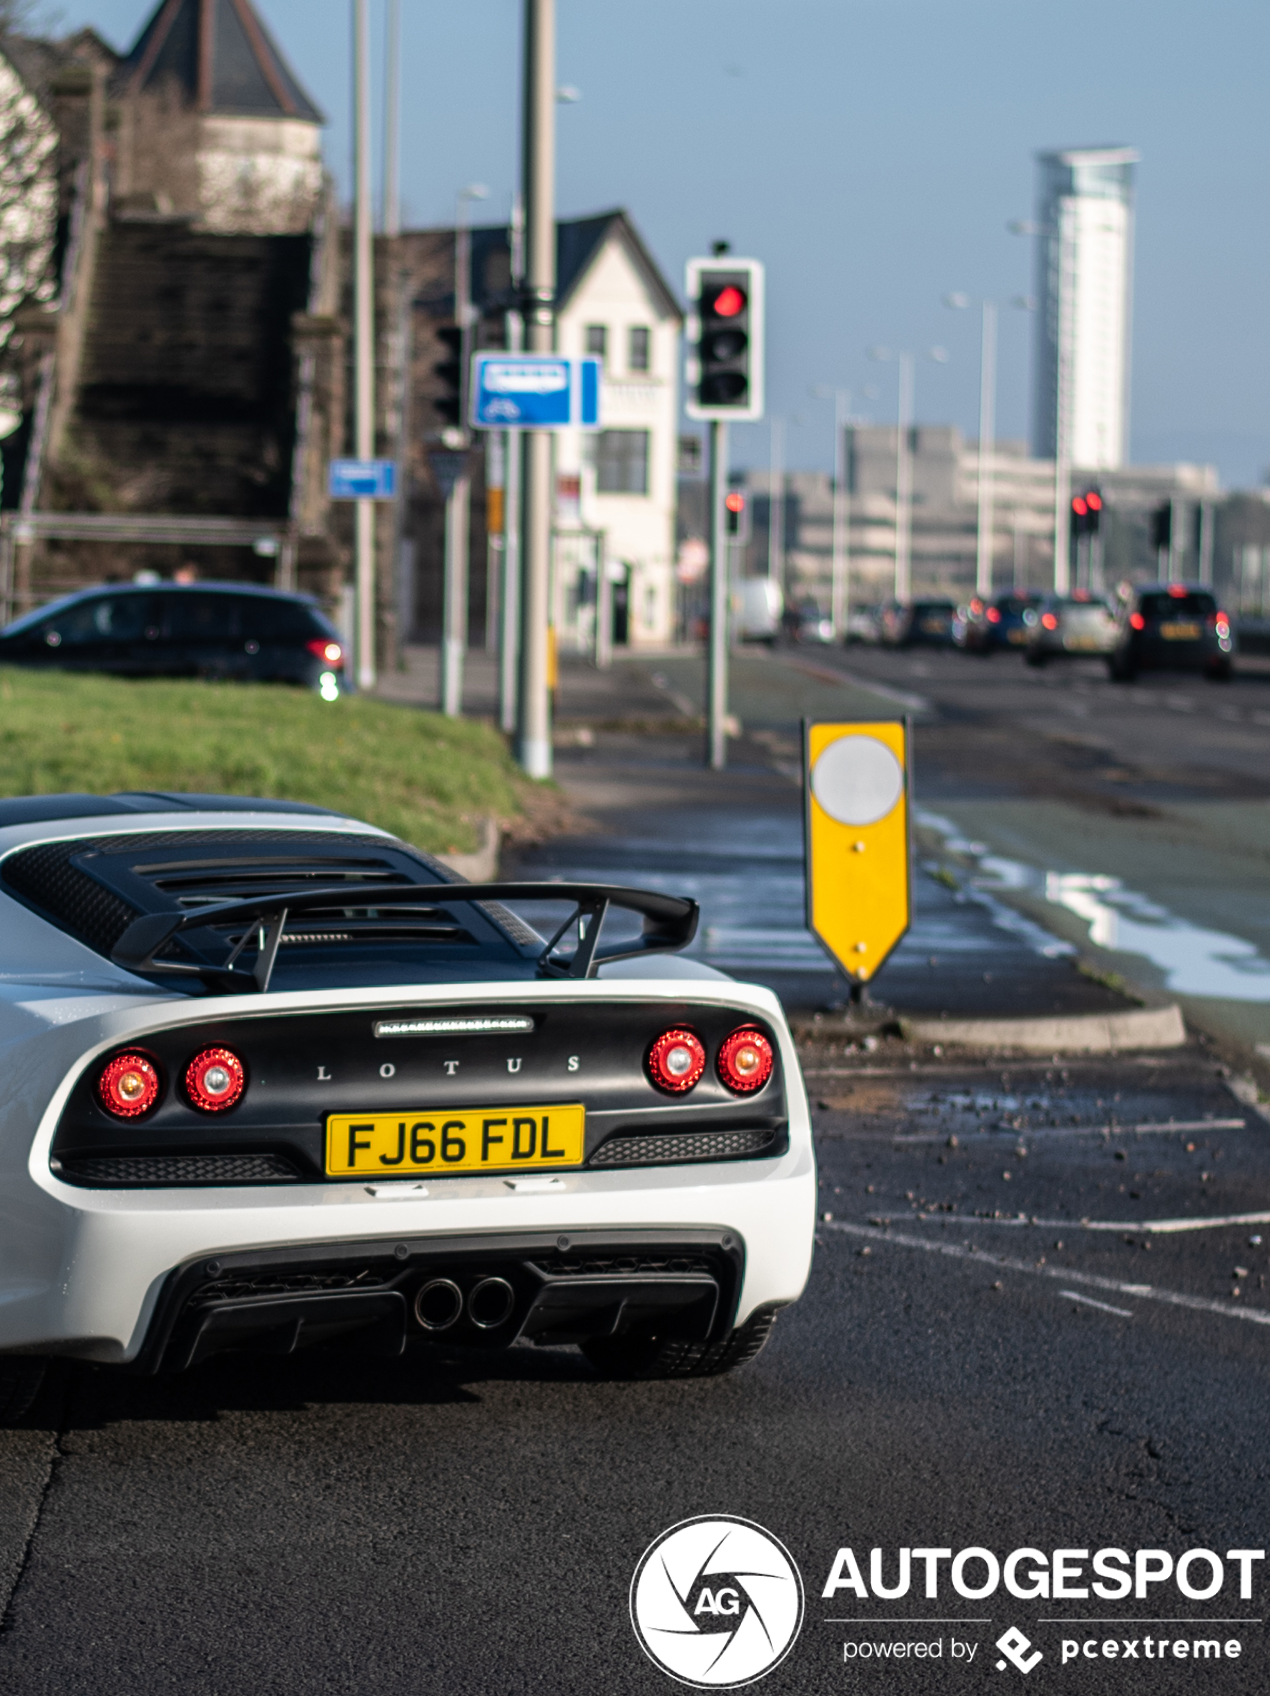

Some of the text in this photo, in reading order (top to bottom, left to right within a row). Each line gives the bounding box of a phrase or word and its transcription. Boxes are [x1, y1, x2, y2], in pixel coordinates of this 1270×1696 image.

[316, 1055, 580, 1080] LOTUS
[347, 1115, 566, 1167] FJ66 FDL
